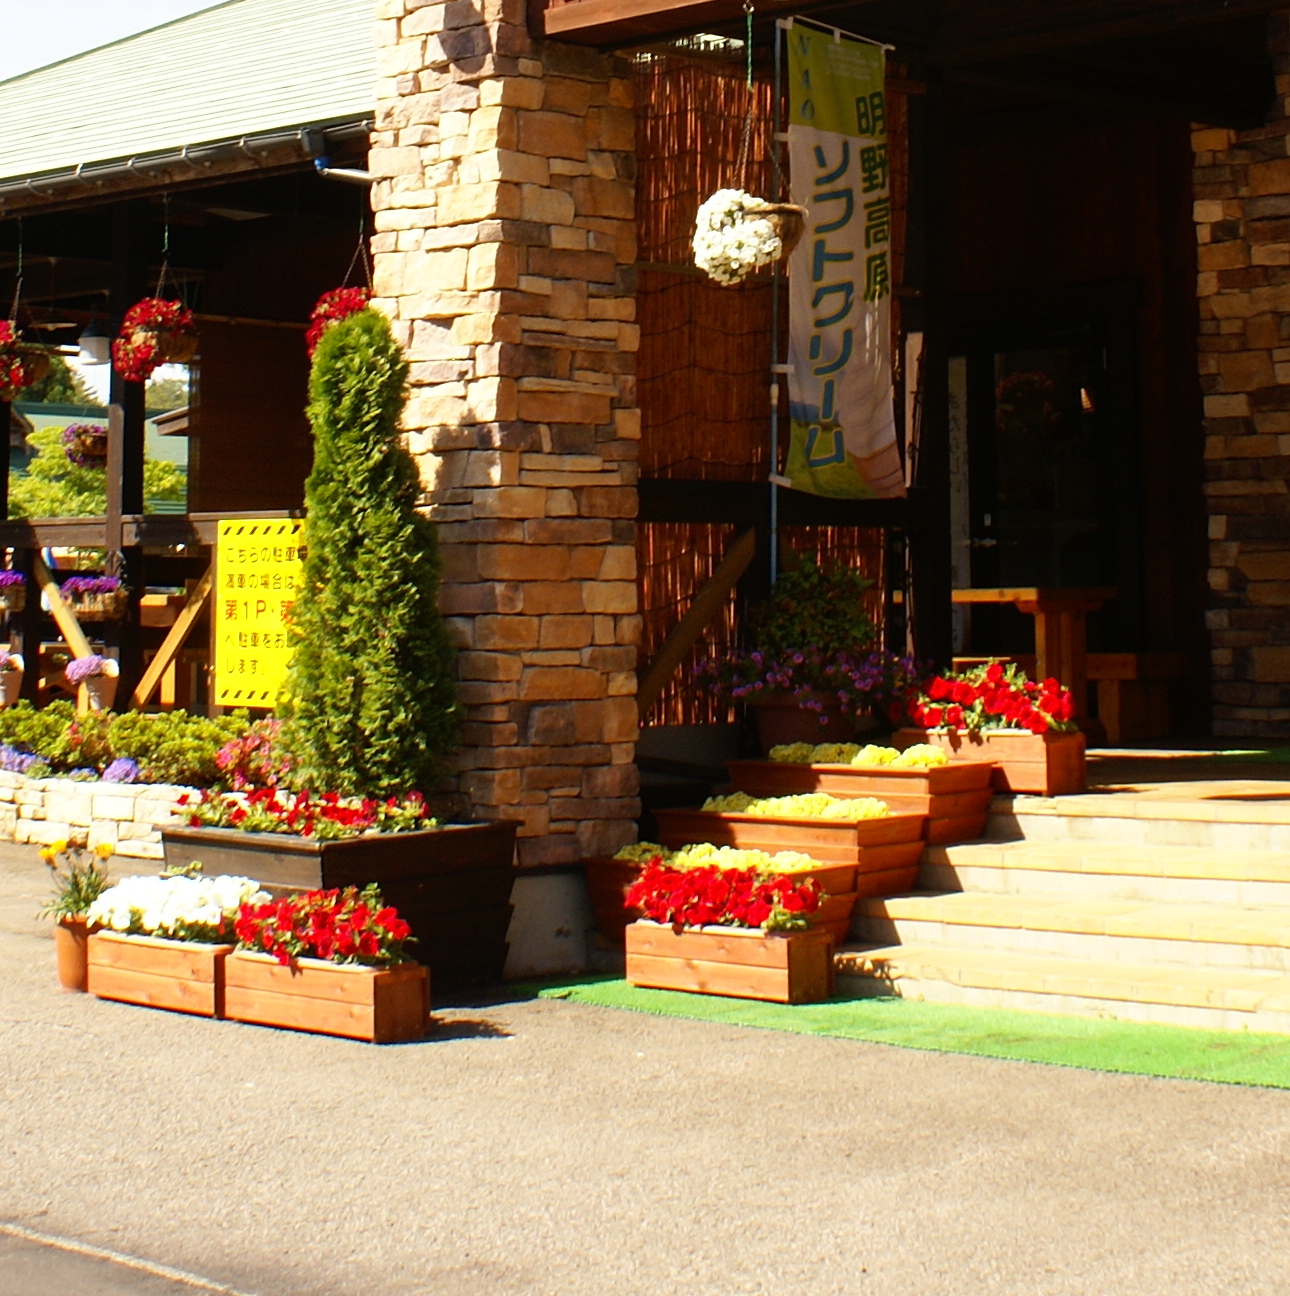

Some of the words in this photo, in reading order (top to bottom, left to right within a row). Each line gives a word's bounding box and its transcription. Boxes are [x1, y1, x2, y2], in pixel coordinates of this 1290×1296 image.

[805, 139, 855, 468] ソフトクリーム
[856, 89, 890, 303] 明野高原
